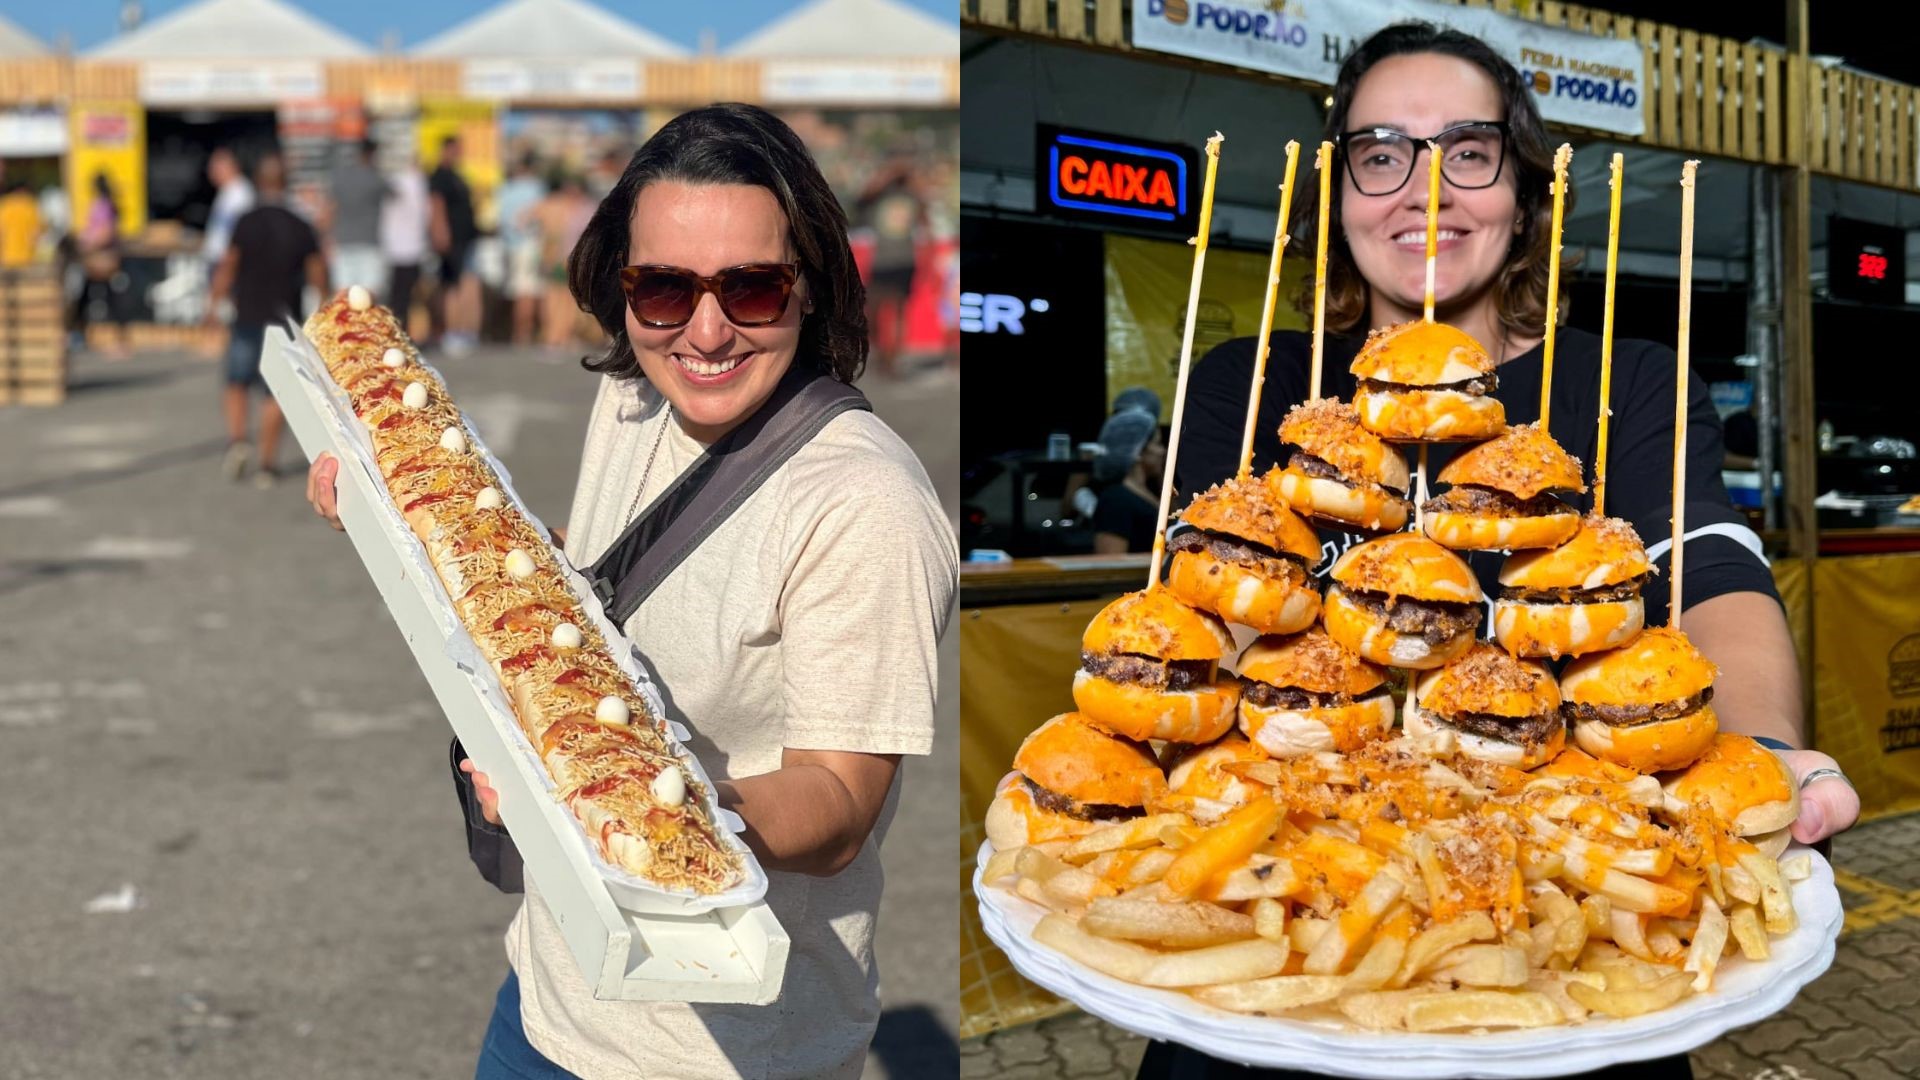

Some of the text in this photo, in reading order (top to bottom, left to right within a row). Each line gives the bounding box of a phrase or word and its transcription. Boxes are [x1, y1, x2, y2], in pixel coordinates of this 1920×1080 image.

[1522, 47, 1635, 81] FEIRA NACIONAL
[1556, 75, 1636, 108] PODRÃO
[1060, 156, 1176, 207] CAIXA
